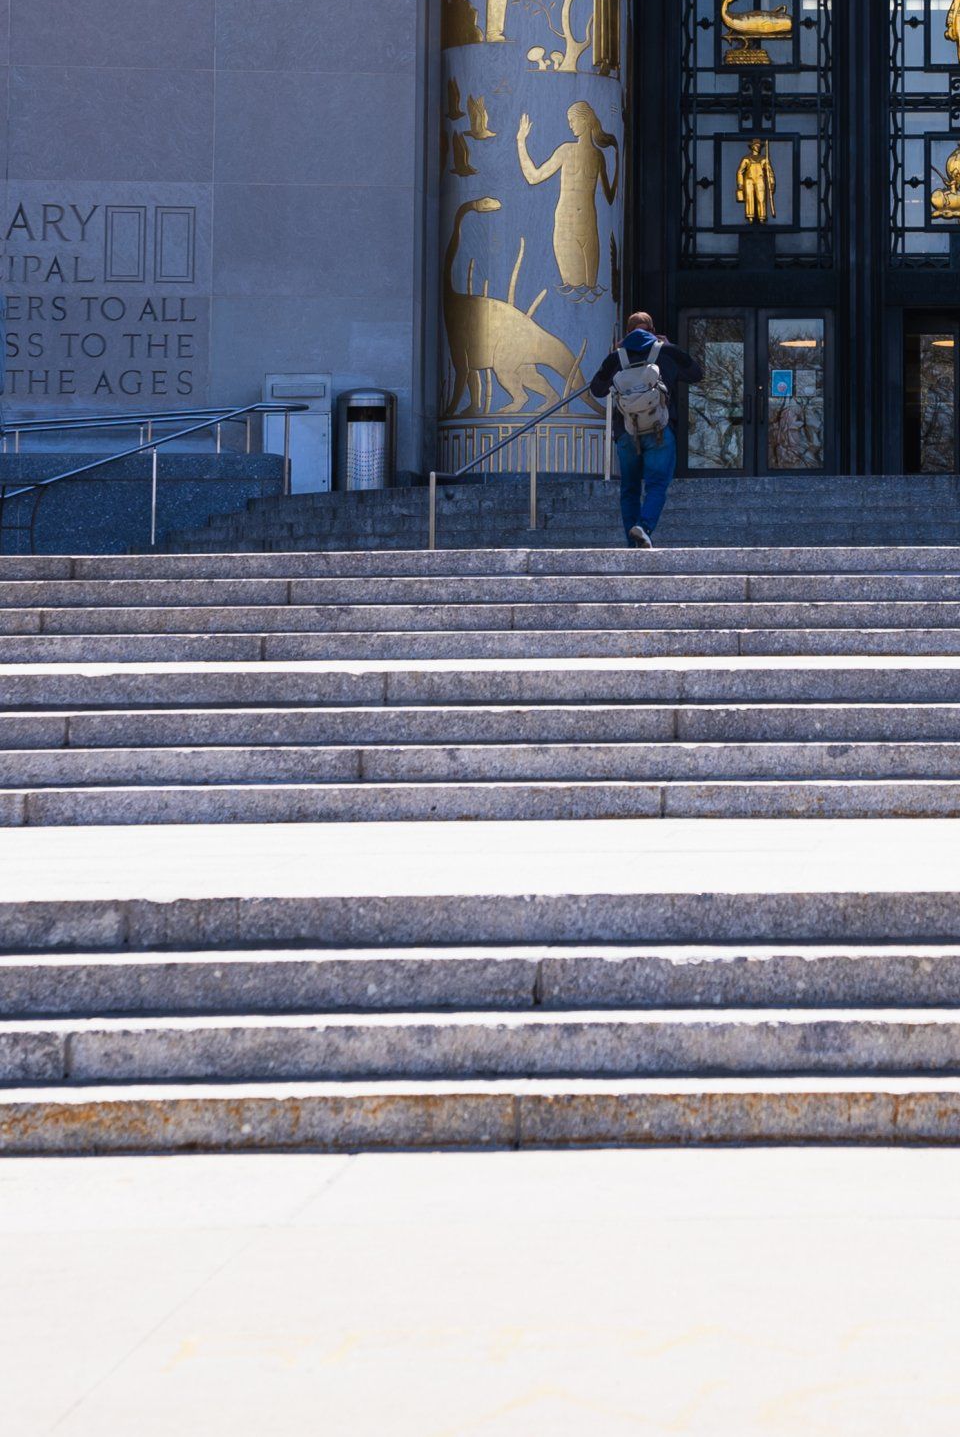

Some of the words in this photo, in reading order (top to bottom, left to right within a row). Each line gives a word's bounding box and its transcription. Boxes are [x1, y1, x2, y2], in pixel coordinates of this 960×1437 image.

[0, 201, 100, 242] ARY
[0, 255, 96, 283] IPAL
[80, 296, 126, 322] TO
[138, 297, 197, 322] ALL
[60, 332, 106, 358] TO
[122, 333, 194, 359] THE
[5, 369, 76, 394] THE
[92, 369, 193, 395] AGES
